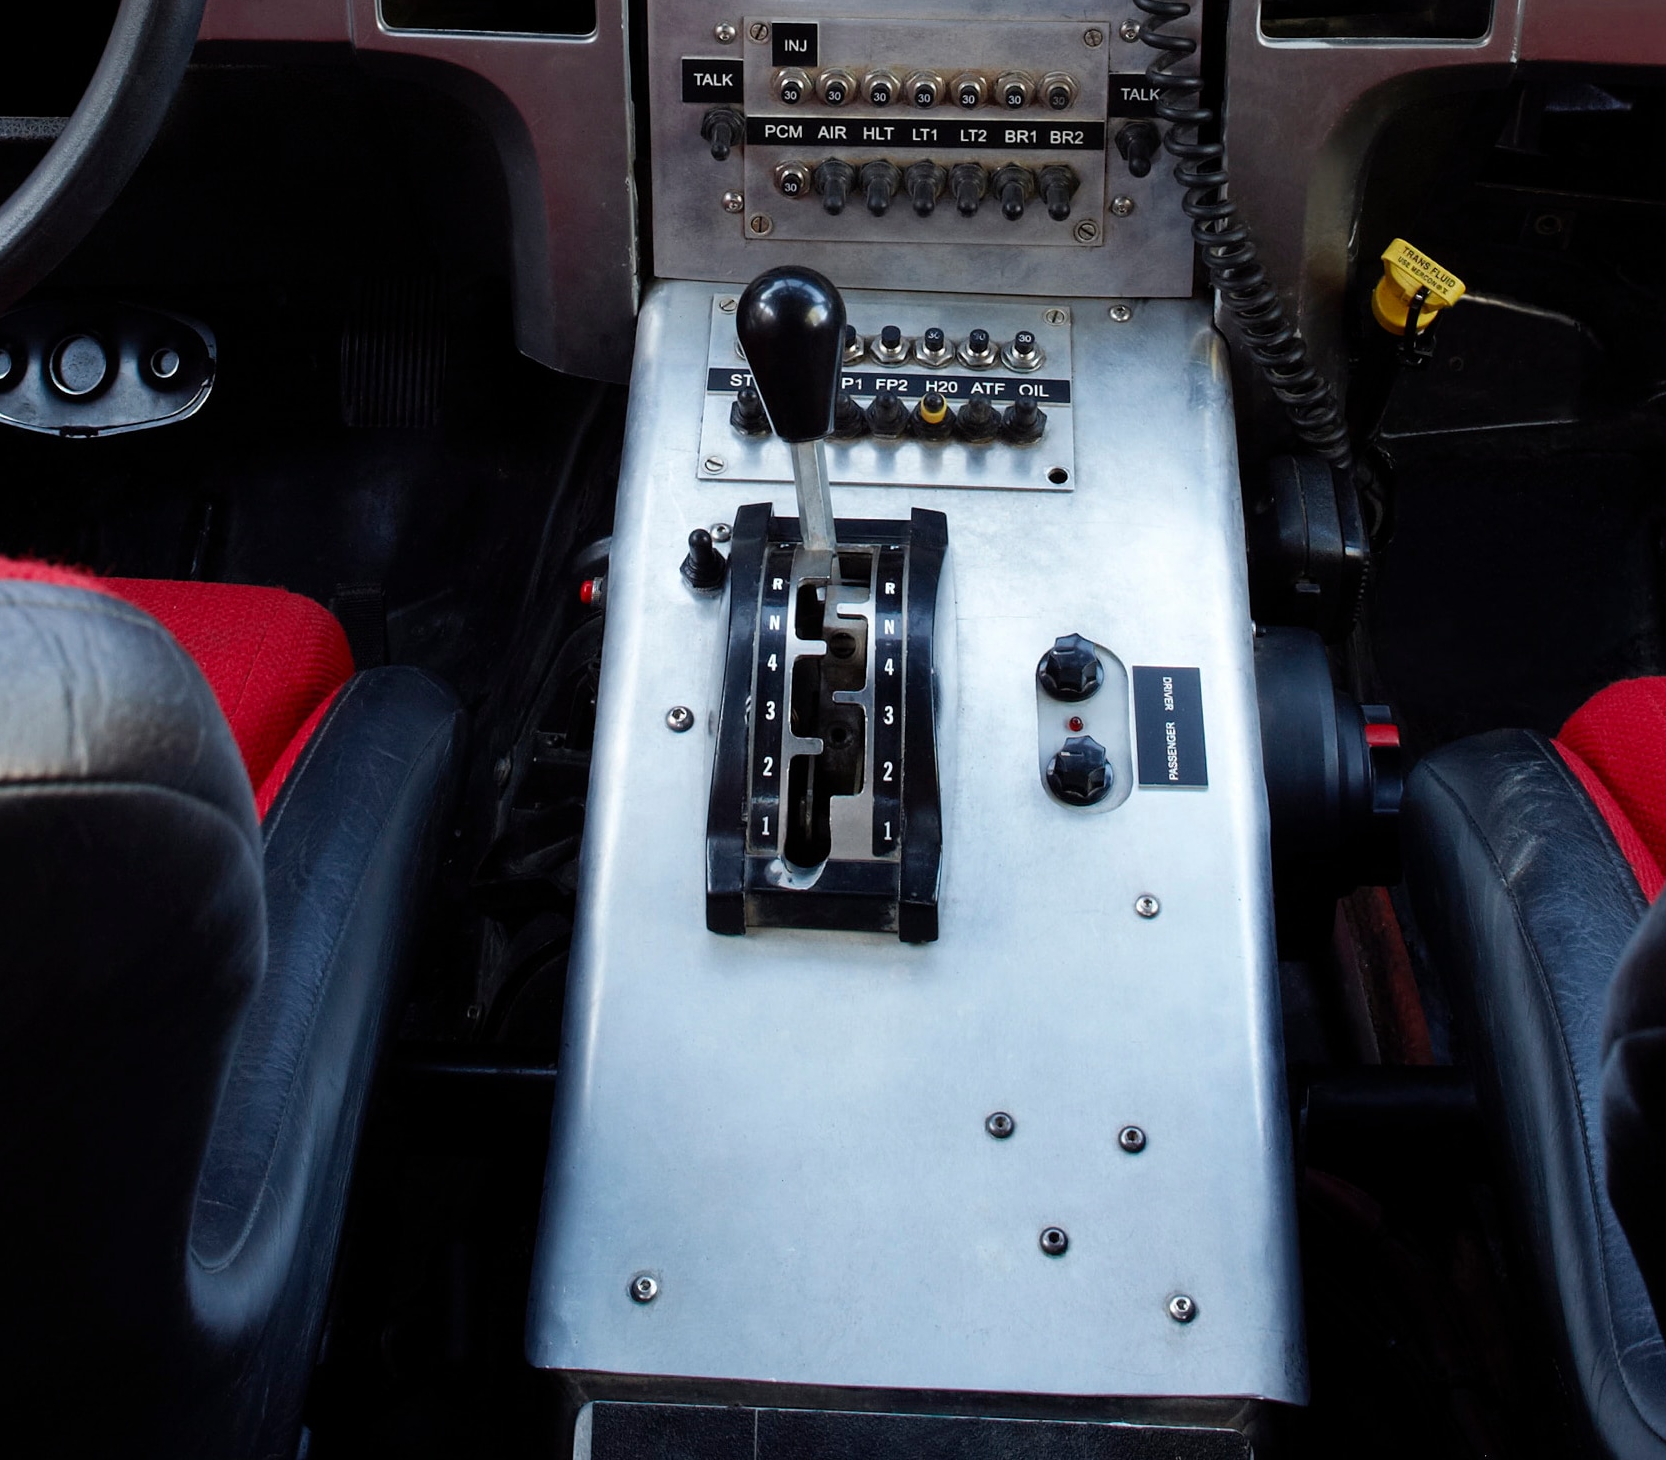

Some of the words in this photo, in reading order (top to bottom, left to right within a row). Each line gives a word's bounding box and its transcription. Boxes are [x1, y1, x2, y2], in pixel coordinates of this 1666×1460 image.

[784, 39, 808, 52] INJ
[694, 73, 733, 86] TALK
[784, 91, 797, 100] 30
[828, 91, 841, 101] 30
[873, 92, 886, 101] 30
[918, 94, 931, 102] 30
[962, 95, 975, 104] 30
[1008, 95, 1021, 105] 30
[1121, 88, 1160, 101] TALK
[764, 125, 803, 138] PCM
[817, 126, 847, 140] AIR
[863, 127, 894, 140] HLT
[913, 128, 937, 141] LT1
[960, 129, 987, 142] LT2
[1004, 129, 1037, 143] BR1
[1050, 130, 1084, 144] BR2
[784, 183, 797, 192] 30
[1402, 246, 1431, 270] TRANS
[1430, 267, 1456, 288] FLUID
[1019, 334, 1032, 343] 30
[730, 374, 753, 387] ST
[841, 377, 862, 390] P1
[876, 379, 908, 391] FP2
[971, 382, 1005, 395] ATF
[1019, 384, 1049, 397] OIL
[772, 578, 783, 590] R
[885, 582, 895, 594] R
[769, 615, 780, 630] N
[884, 620, 895, 634] N
[767, 654, 778, 671] 4
[884, 658, 894, 676] 4
[1163, 677, 1174, 711] DRIVER
[765, 701, 776, 720] 3
[884, 705, 894, 725] 3
[1166, 721, 1179, 781] PASSENGER
[762, 756, 773, 777] 2
[883, 761, 893, 782] 2
[762, 816, 770, 836] 1
[884, 821, 892, 840] 1
